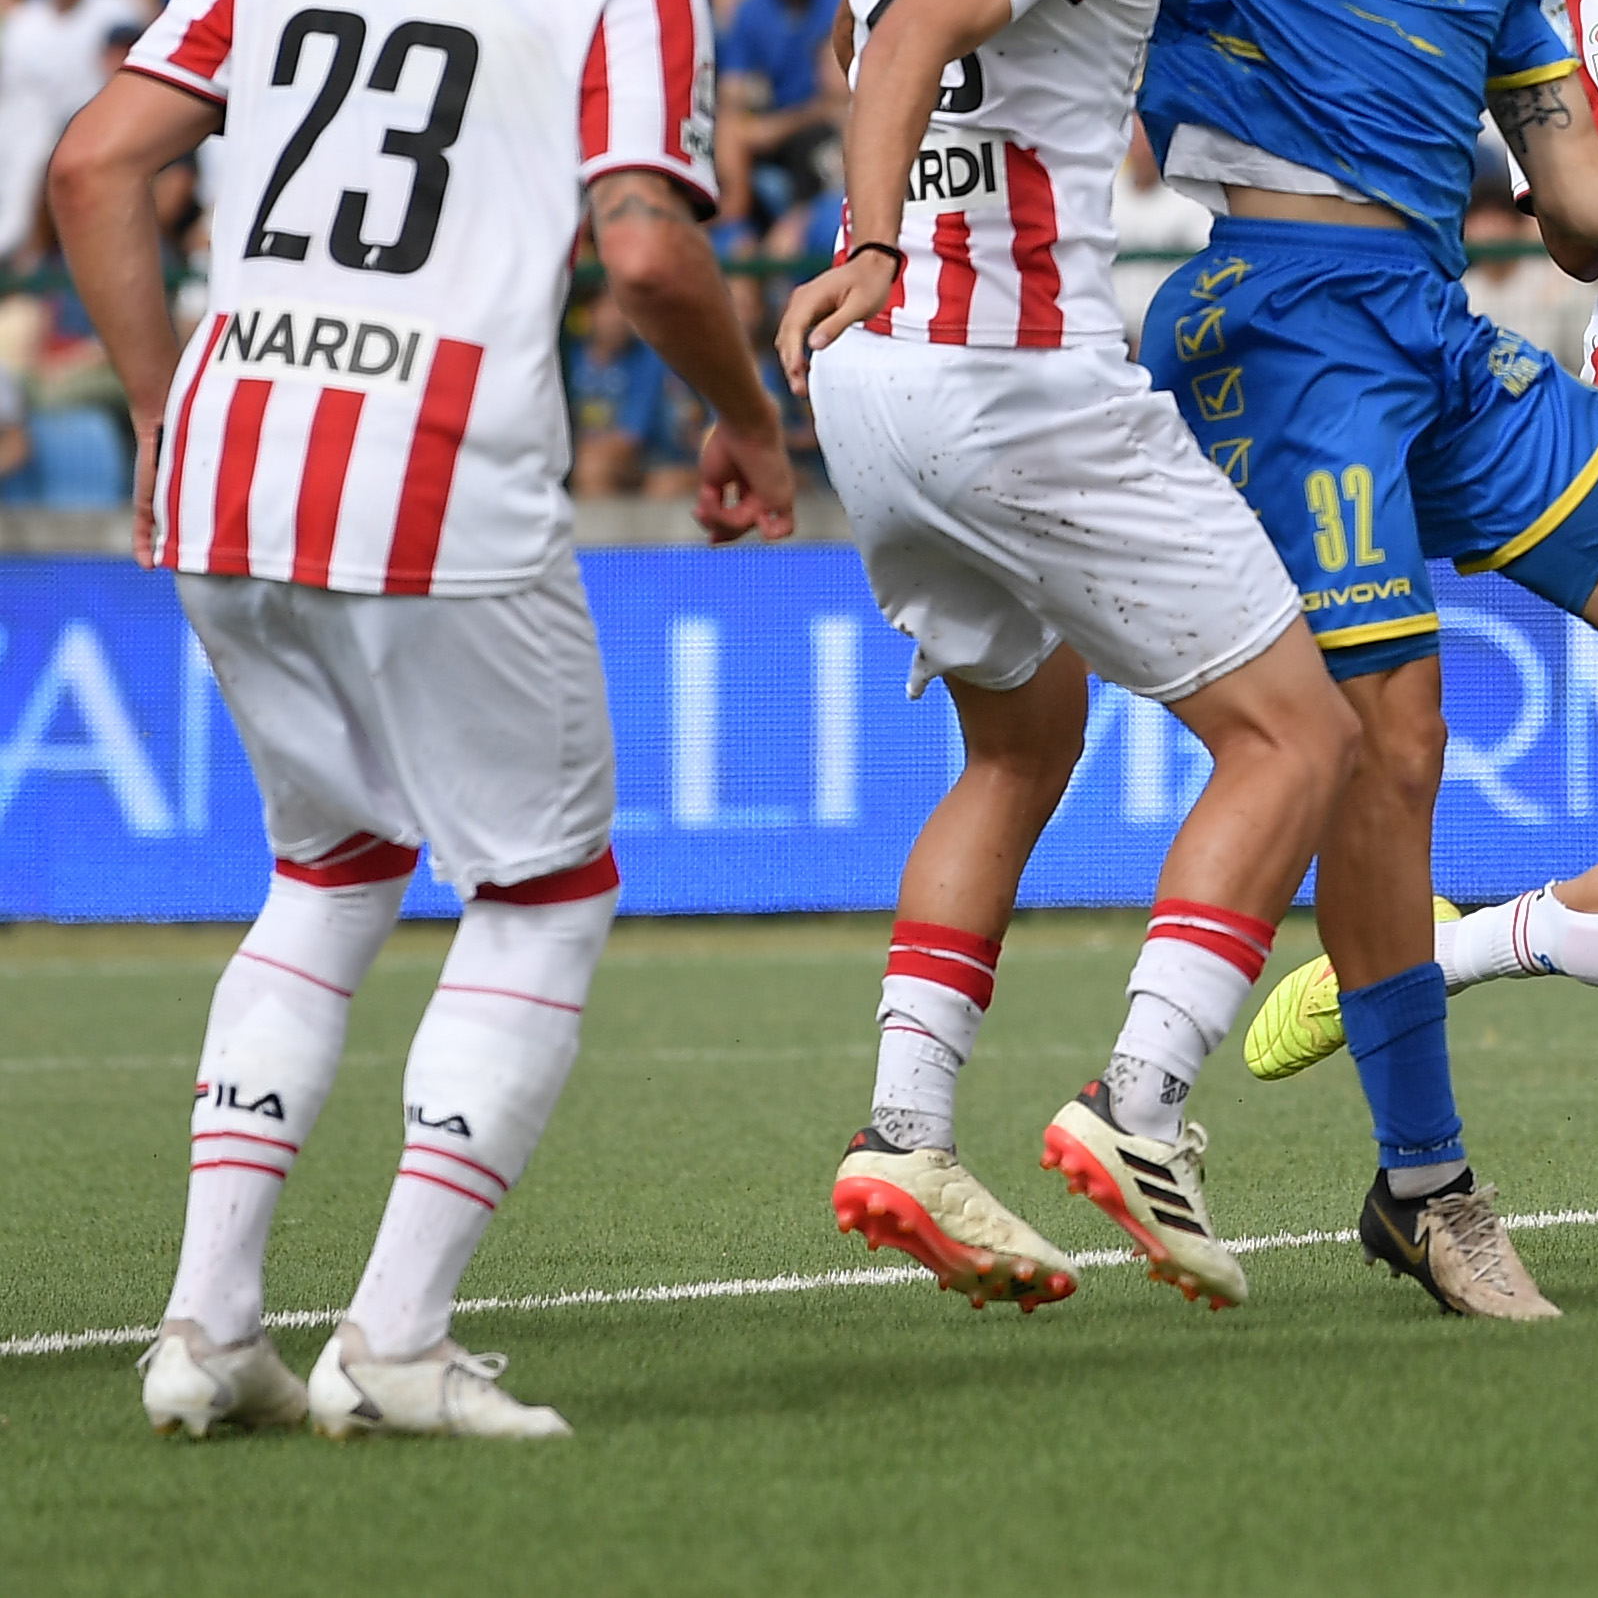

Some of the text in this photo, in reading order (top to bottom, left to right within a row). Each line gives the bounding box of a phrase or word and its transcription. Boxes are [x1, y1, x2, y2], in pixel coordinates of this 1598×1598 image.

[243, 8, 479, 274] 23
[904, 141, 997, 203] ARDI
[219, 310, 422, 382] NARDI
[1304, 463, 1386, 573] 32
[1301, 577, 1412, 612] GIVOVA
[408, 1104, 471, 1138] ILA
